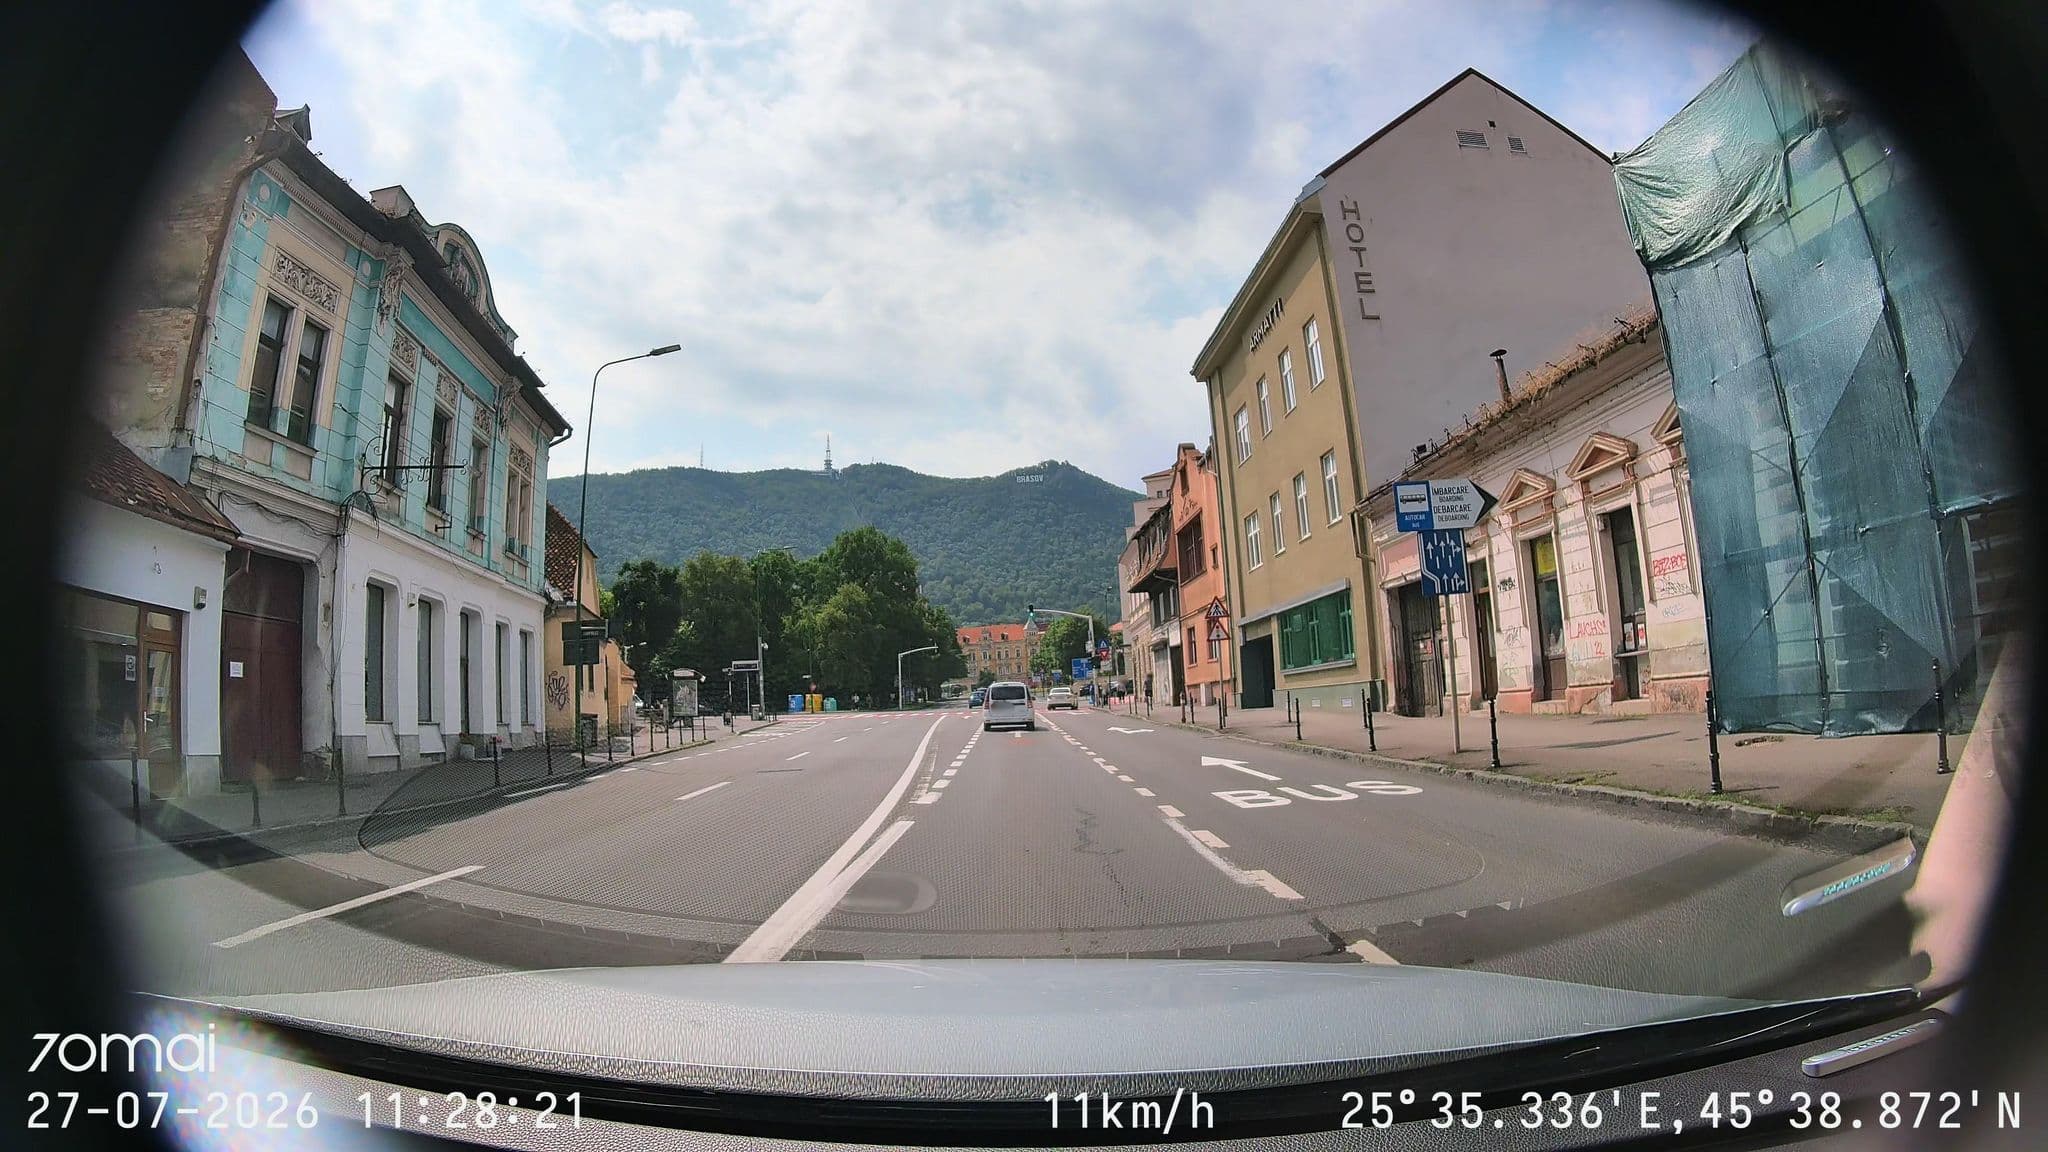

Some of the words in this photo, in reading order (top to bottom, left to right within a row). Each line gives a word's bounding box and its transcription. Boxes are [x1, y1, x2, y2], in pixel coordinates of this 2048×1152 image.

[1340, 199, 1381, 320] HOTEL
[1016, 474, 1044, 483] BRASOV
[1433, 503, 1472, 514] DEBARCARE
[1211, 780, 1424, 809] BUS
